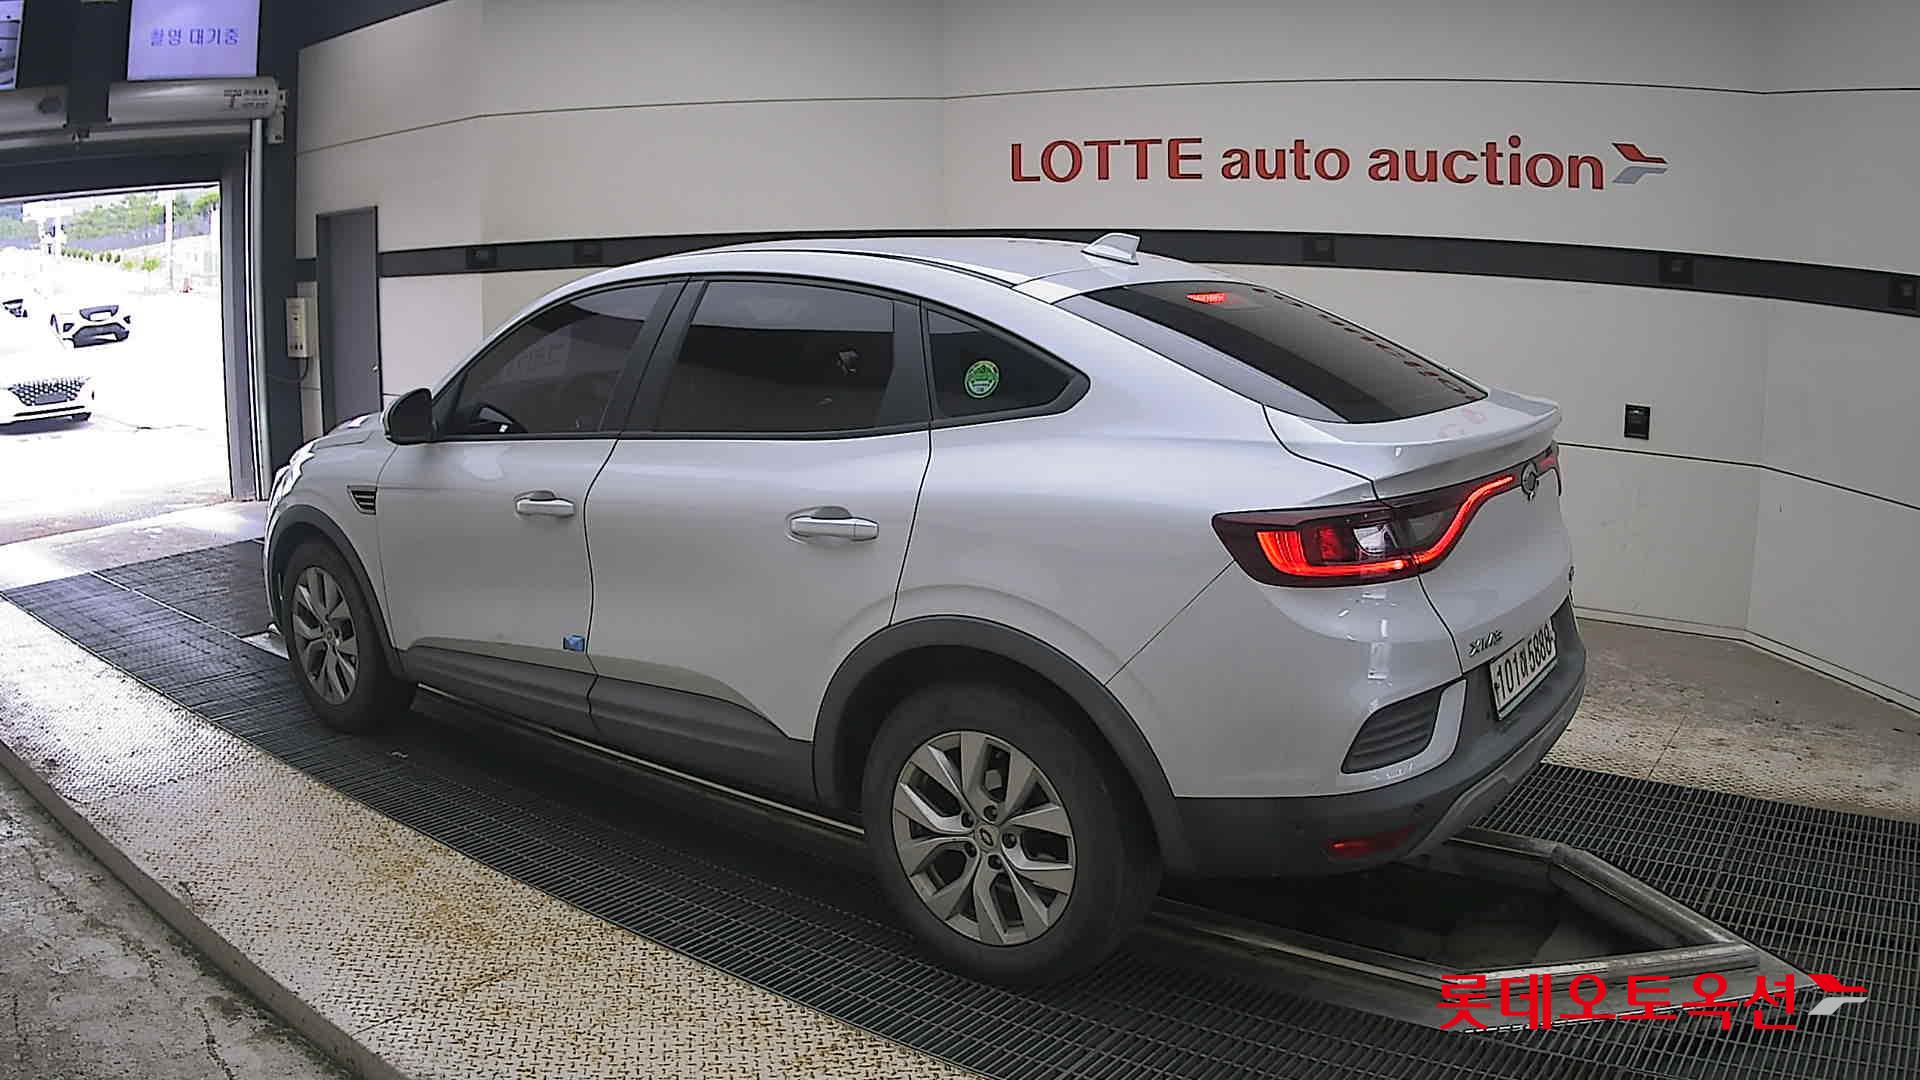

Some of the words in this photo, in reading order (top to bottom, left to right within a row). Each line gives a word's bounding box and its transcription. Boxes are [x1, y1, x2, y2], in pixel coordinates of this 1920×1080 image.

[190, 28, 238, 45] 대기중
[1010, 137, 1203, 184] LOTTE
[1220, 139, 1351, 182] auto
[1367, 136, 1606, 191] auction
